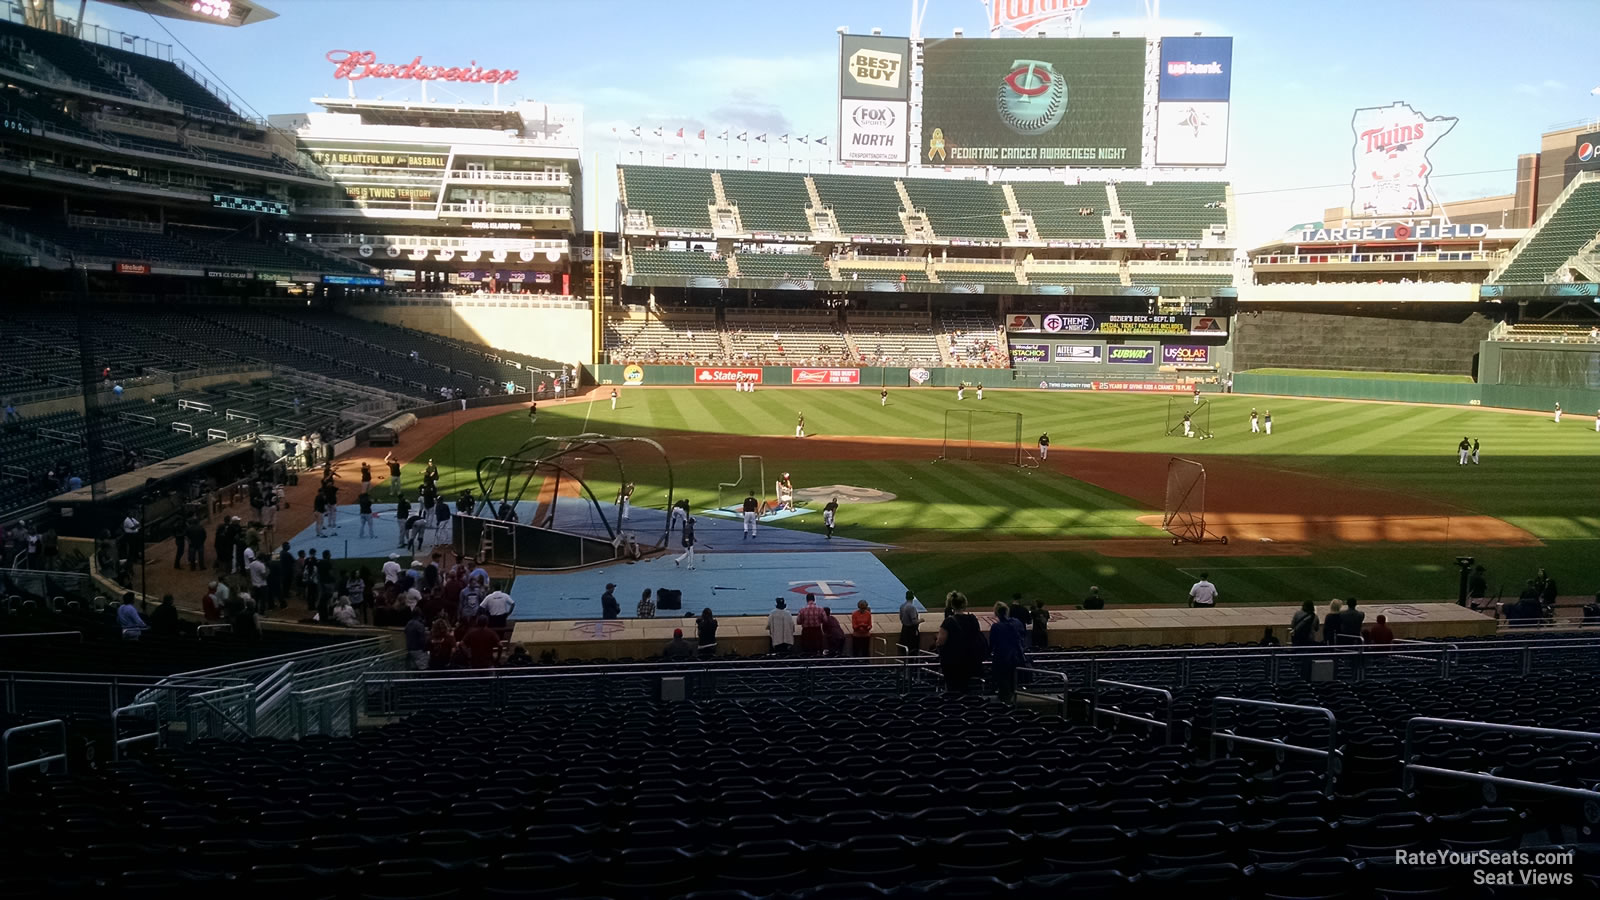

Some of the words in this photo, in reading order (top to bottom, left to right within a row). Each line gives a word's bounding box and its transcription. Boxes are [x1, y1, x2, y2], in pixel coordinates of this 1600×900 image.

[326, 49, 519, 84] Budweiser
[856, 55, 899, 71] BEST
[857, 67, 895, 81] BUY
[861, 108, 886, 120] FOX
[852, 133, 894, 146] NORTH
[1360, 123, 1424, 154] Twins
[951, 147, 999, 159] PEDIATRIC
[1001, 147, 1037, 159] CANCER
[1040, 147, 1096, 159] AWARENESS
[1098, 147, 1127, 159] NIGHT
[332, 154, 337, 162] A
[339, 154, 380, 164] BEAUTIFUL
[381, 156, 394, 165] DAY
[409, 156, 445, 167] BASEBALL
[346, 187, 360, 195] THIS
[361, 187, 368, 196] IS
[369, 188, 396, 198] TWINS
[397, 189, 431, 197] TERRITORY
[1302, 225, 1392, 241] TARGET
[1415, 223, 1487, 239] FIELD
[1062, 317, 1089, 326] THEME
[1010, 349, 1045, 357] ISTACHIOS
[1110, 349, 1152, 358] SUBWAY
